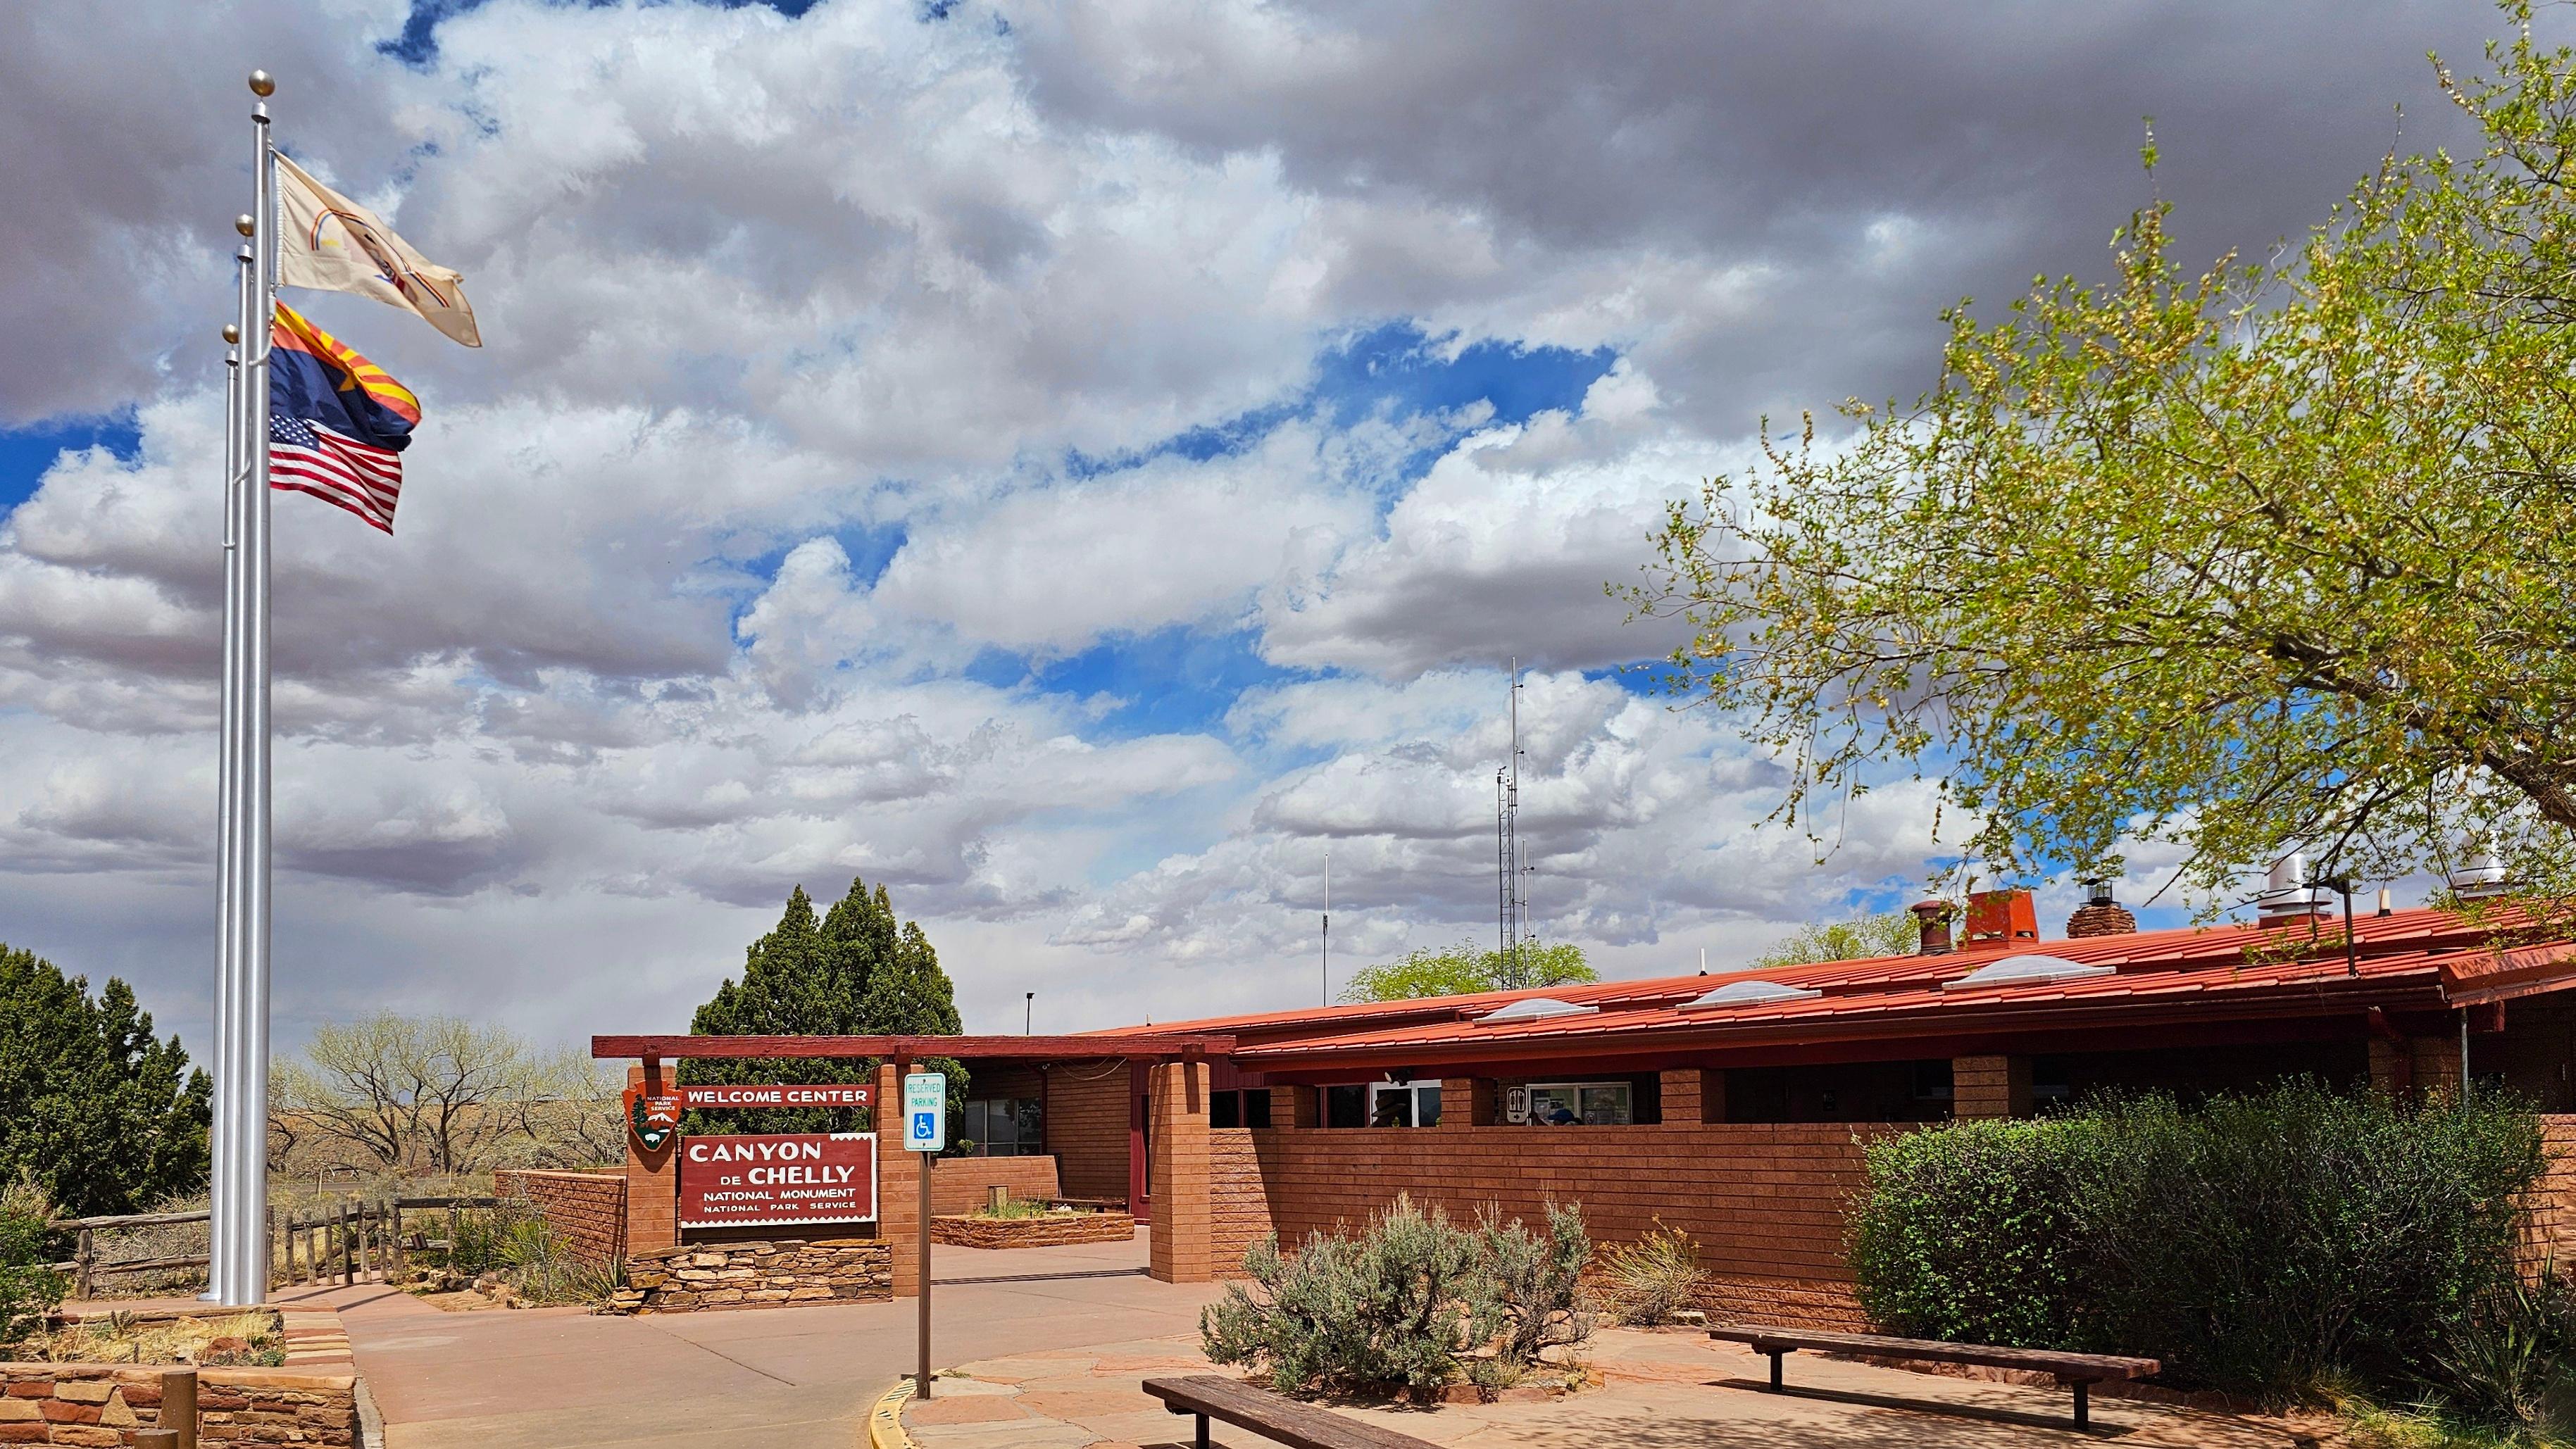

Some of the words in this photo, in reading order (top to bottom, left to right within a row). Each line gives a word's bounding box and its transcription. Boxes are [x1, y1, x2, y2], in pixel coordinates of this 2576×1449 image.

[908, 1083, 941, 1093] RESERVED
[688, 1091, 782, 1103] WELCOME
[787, 1090, 868, 1102] CENTER
[911, 1097, 937, 1107] PARKING
[689, 1142, 821, 1162] CANYON
[720, 1176, 742, 1186] DE
[748, 1165, 855, 1185] CHELLY
[704, 1191, 774, 1202] NATIONAL
[780, 1188, 856, 1200] MONUMENT
[704, 1205, 761, 1213] NATIONAL
[809, 1201, 856, 1210] SERVICE
